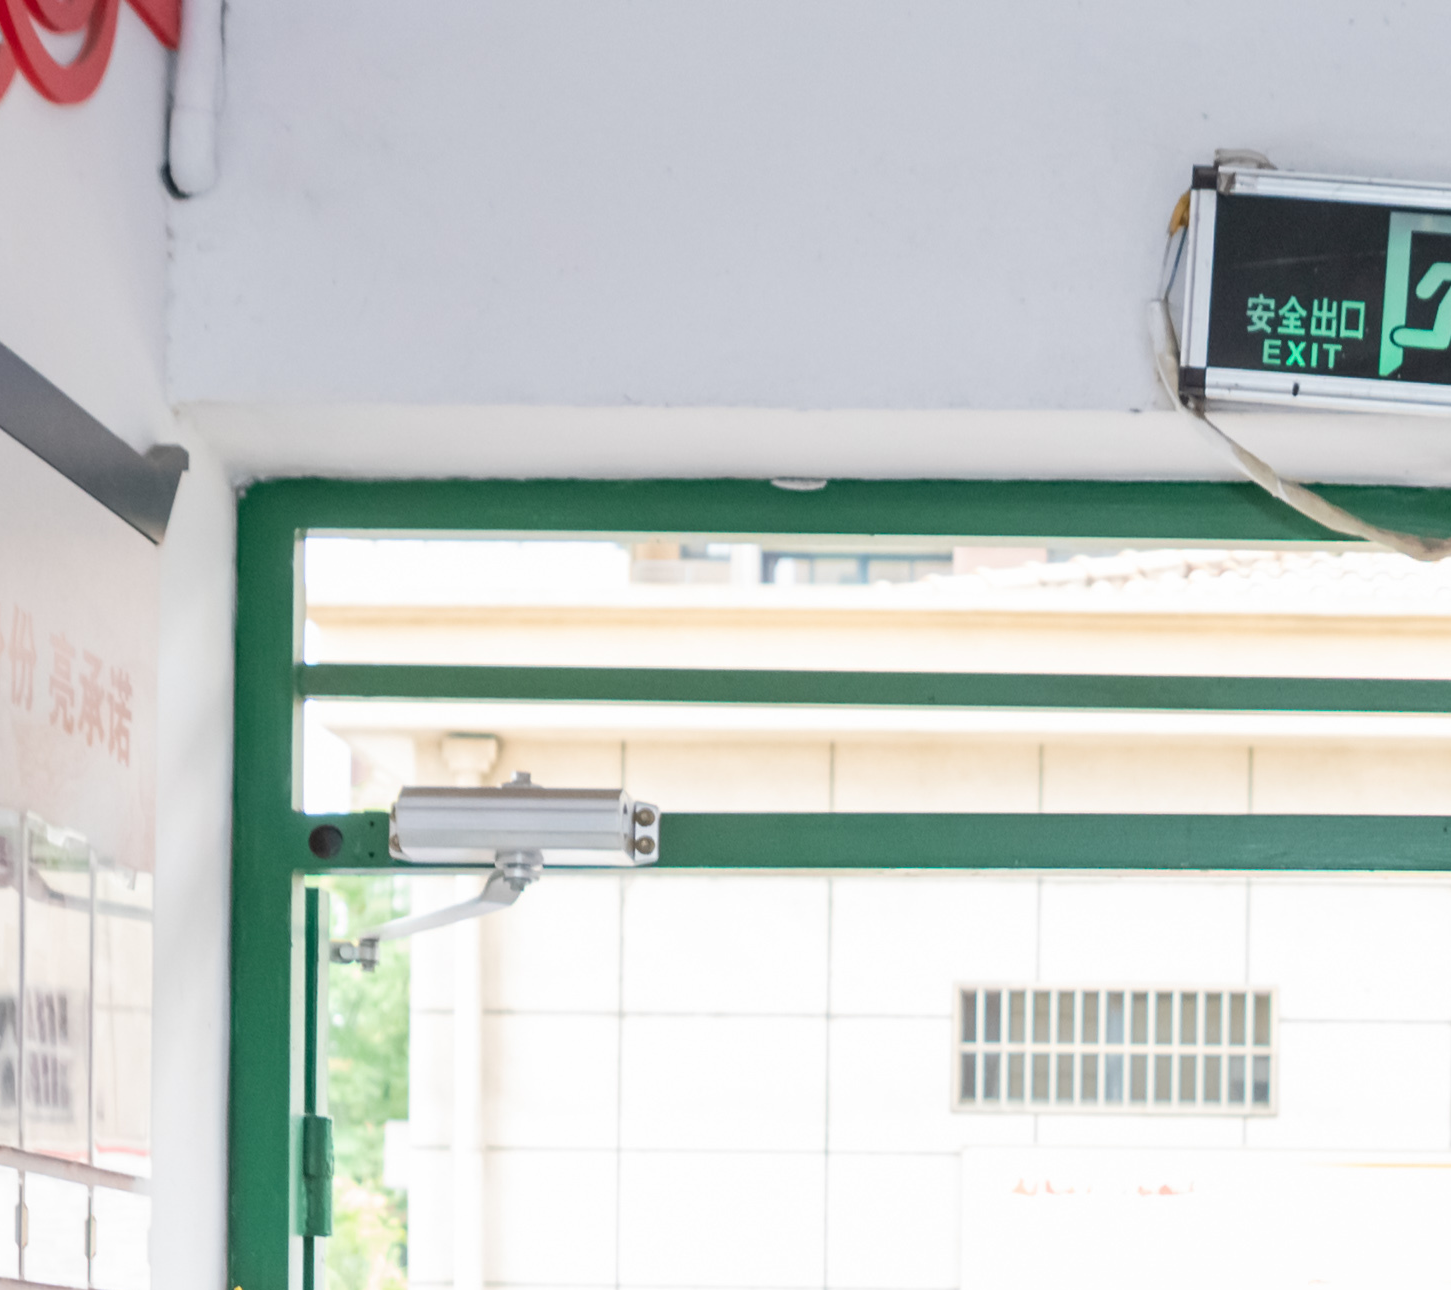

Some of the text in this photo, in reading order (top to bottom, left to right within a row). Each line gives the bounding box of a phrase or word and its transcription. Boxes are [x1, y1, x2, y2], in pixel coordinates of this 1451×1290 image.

[1246, 294, 1366, 341] 安全出口
[1262, 338, 1343, 369] EXIT
[49, 633, 134, 768] 亮承诺
